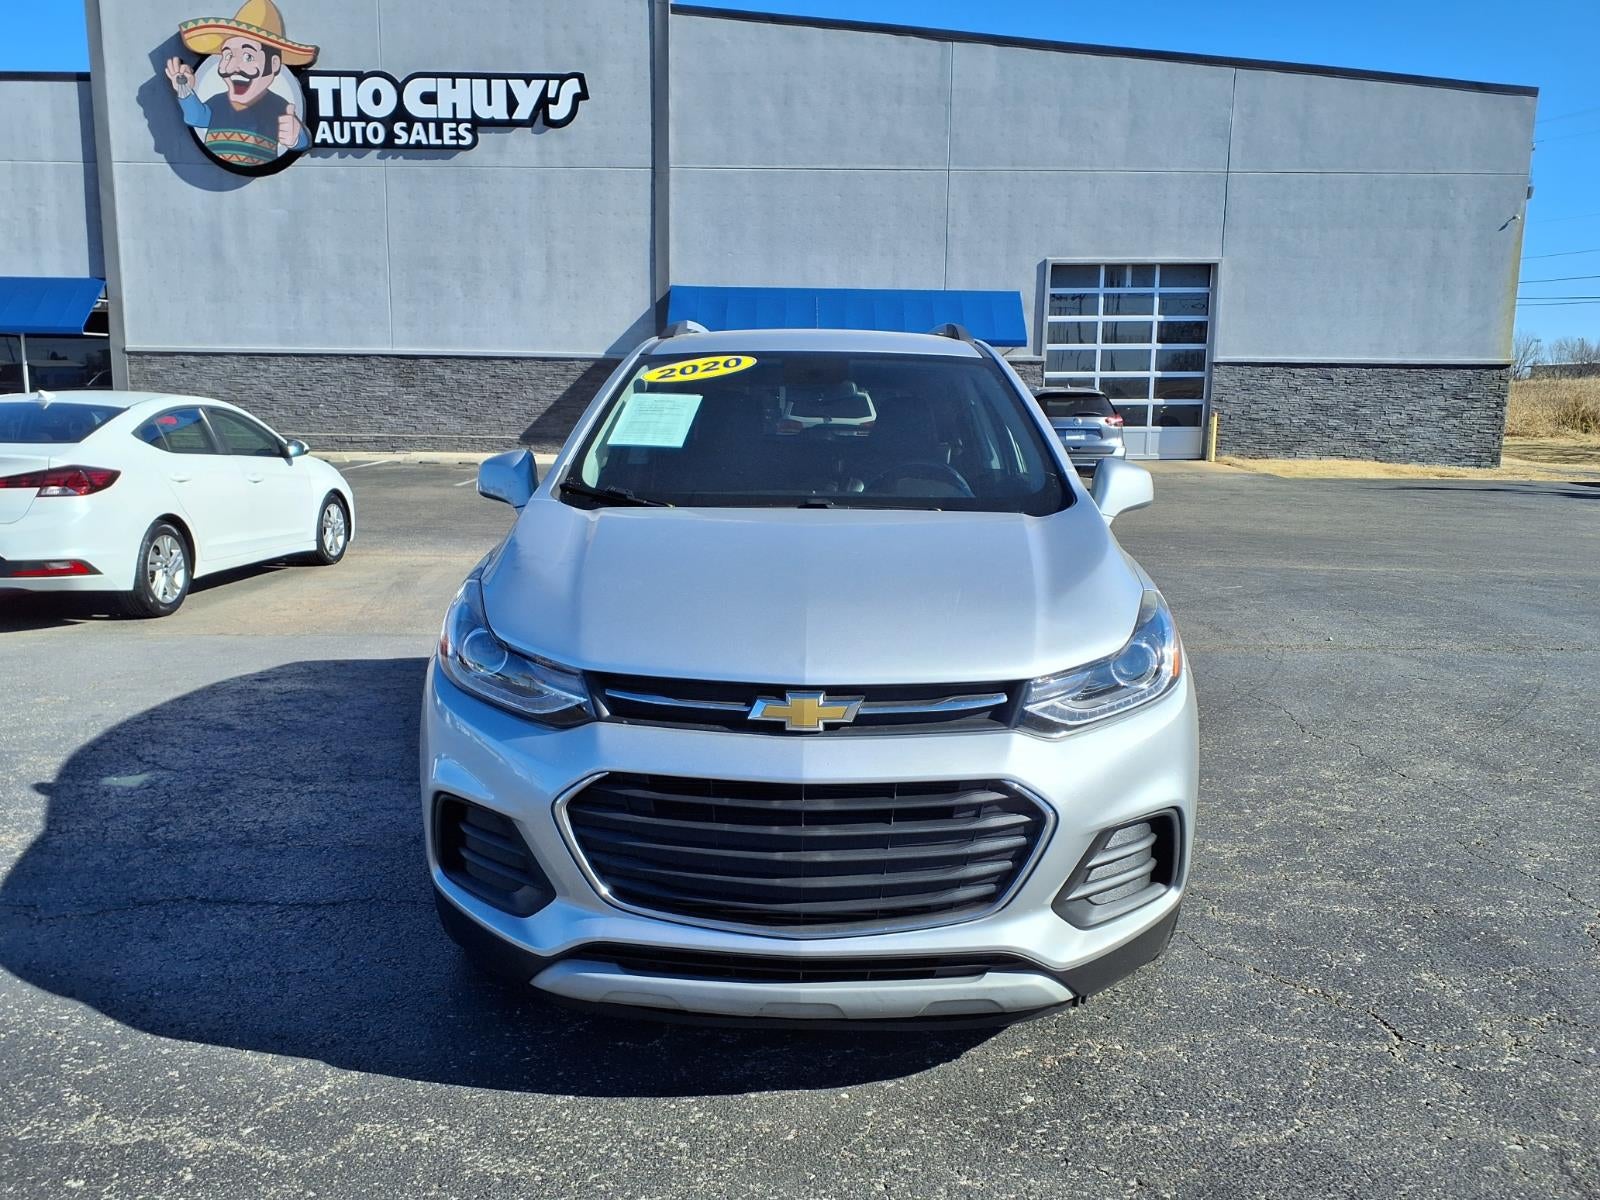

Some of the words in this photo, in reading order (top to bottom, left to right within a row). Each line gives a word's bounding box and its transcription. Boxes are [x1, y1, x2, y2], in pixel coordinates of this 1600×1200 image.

[309, 76, 398, 118] TIO
[314, 120, 387, 145] AUTO
[393, 121, 473, 146] SALES
[656, 357, 742, 380] 2020
